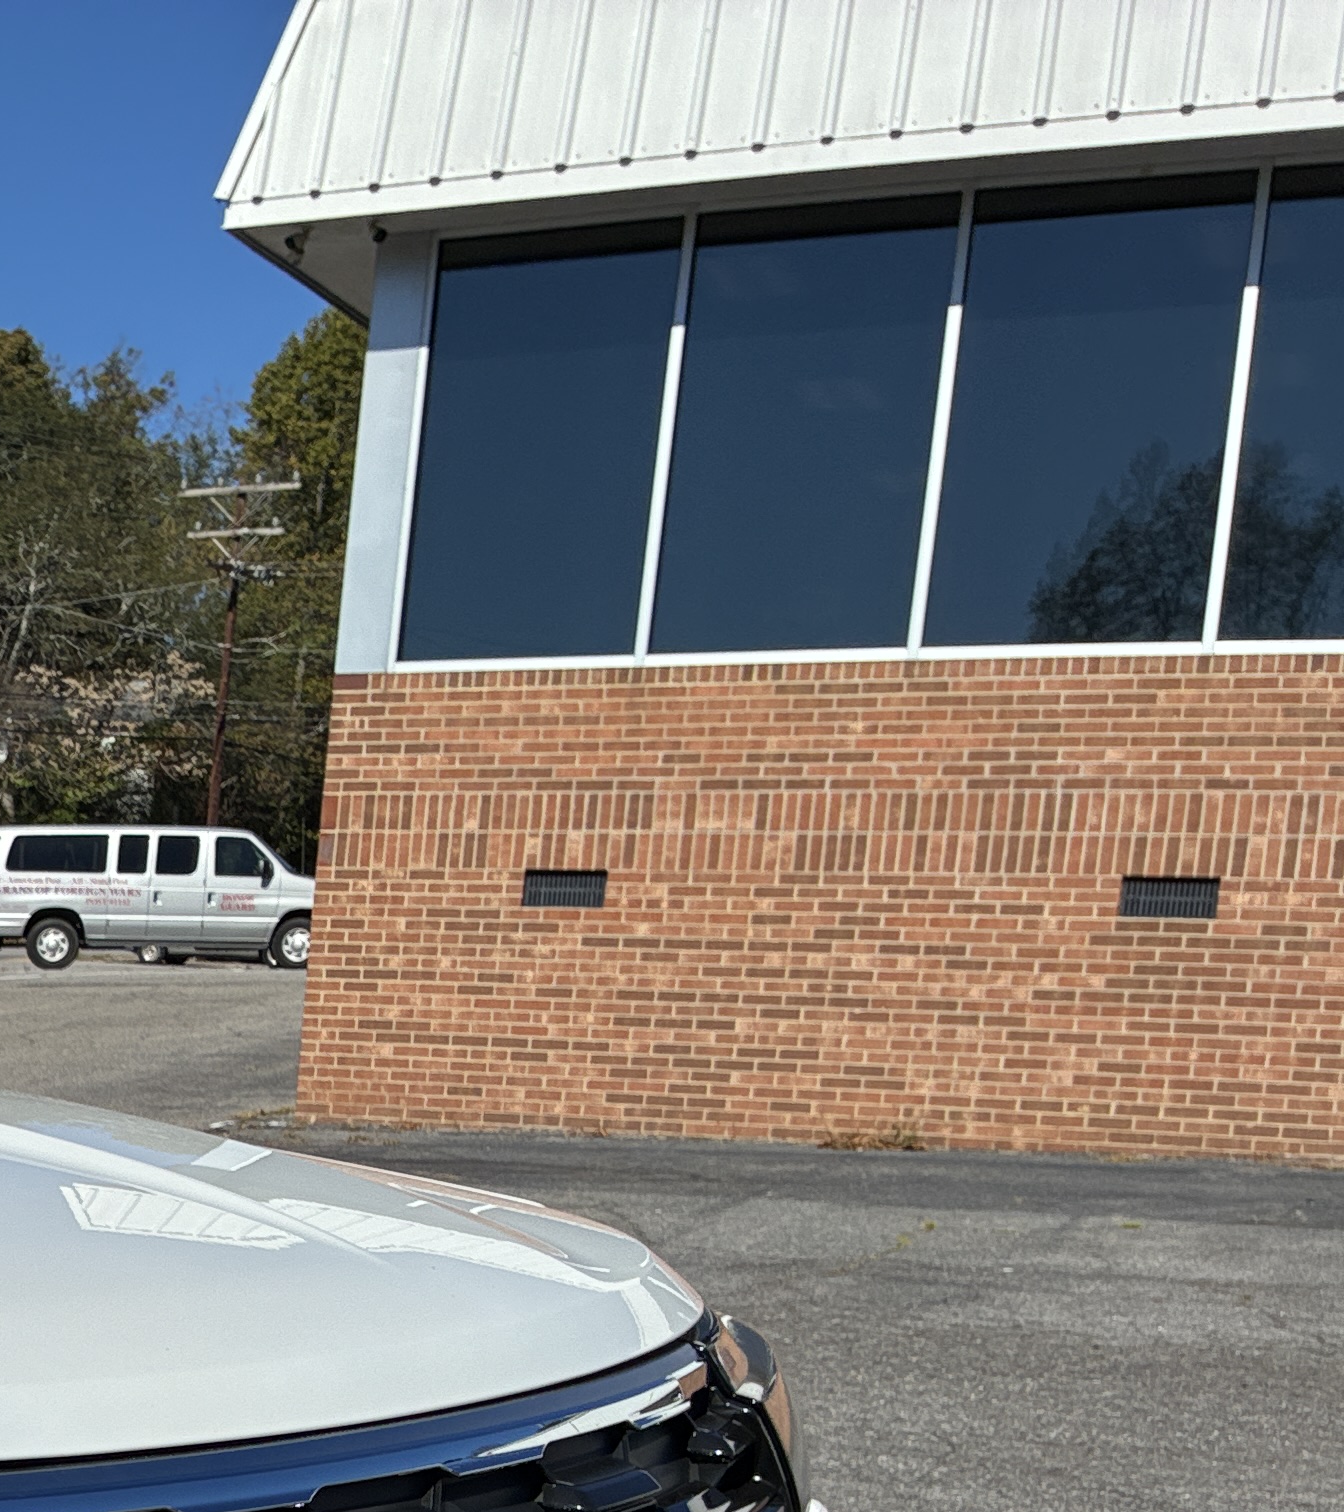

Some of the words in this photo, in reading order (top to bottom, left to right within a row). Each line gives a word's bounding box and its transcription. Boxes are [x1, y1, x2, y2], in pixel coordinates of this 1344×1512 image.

[35, 887, 52, 896] OF
[54, 887, 106, 897] FOREIGN
[109, 887, 142, 898] WARS
